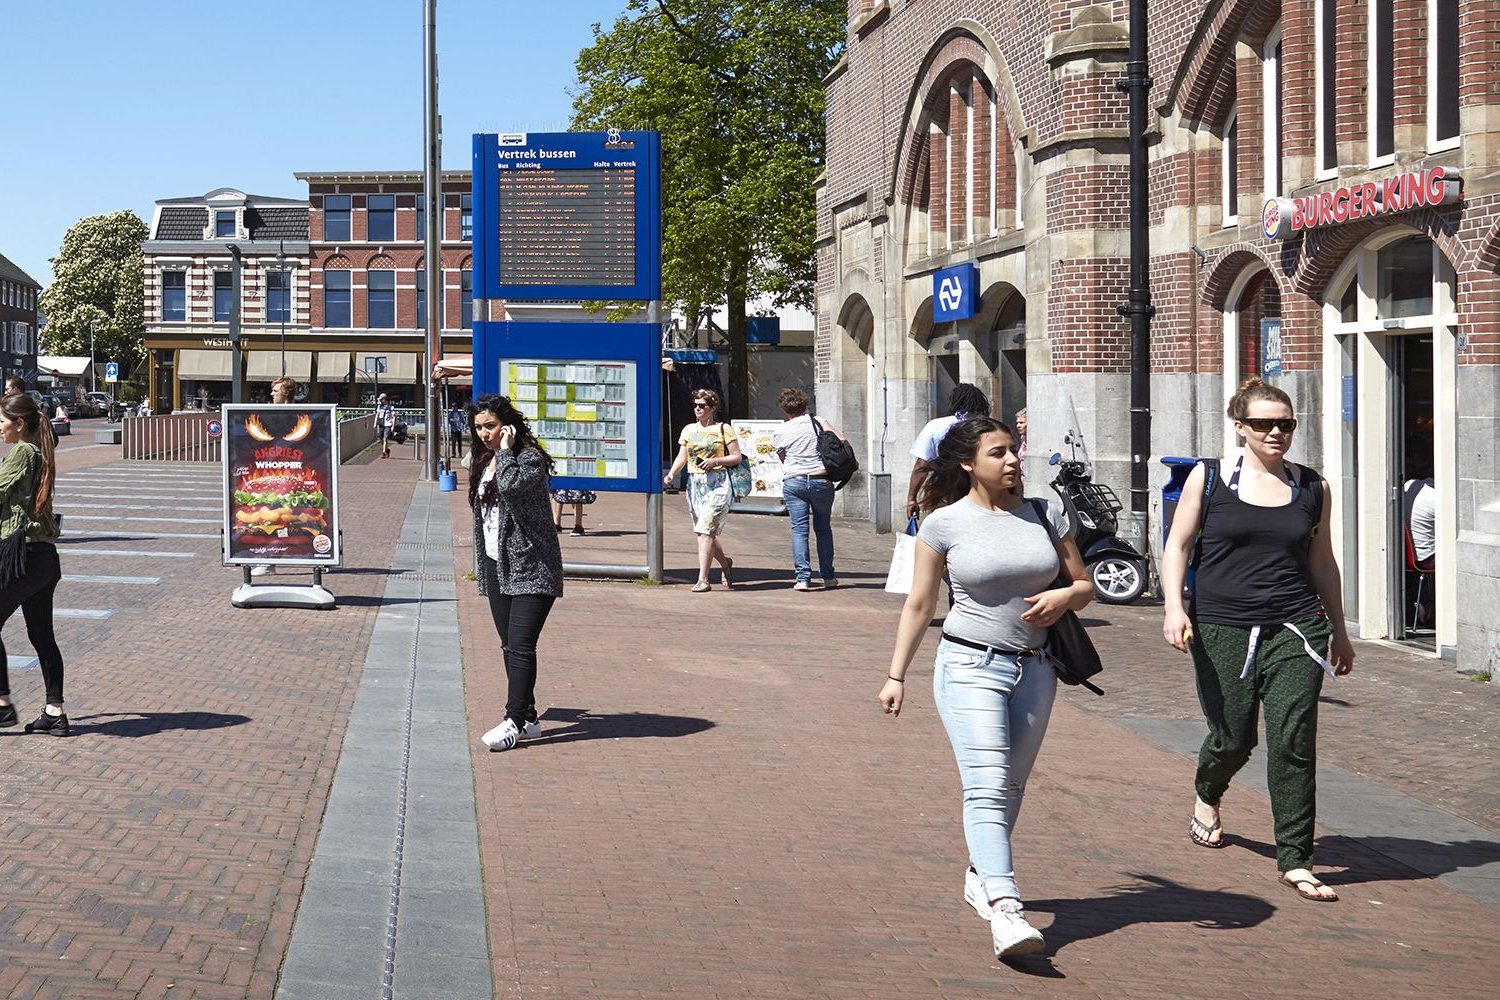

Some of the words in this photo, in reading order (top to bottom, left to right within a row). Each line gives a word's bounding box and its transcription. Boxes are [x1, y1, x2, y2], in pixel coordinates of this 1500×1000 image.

[498, 149, 536, 159] Vertrek
[539, 148, 576, 158] bussen
[1291, 182, 1378, 231] BURGER
[1382, 166, 1445, 214] KING
[1264, 204, 1279, 220] BURGER
[1265, 212, 1279, 231] KING
[203, 337, 249, 347] WESTHFF
[252, 446, 304, 460] ANGRIEST
[255, 461, 302, 469] WHOPPER
